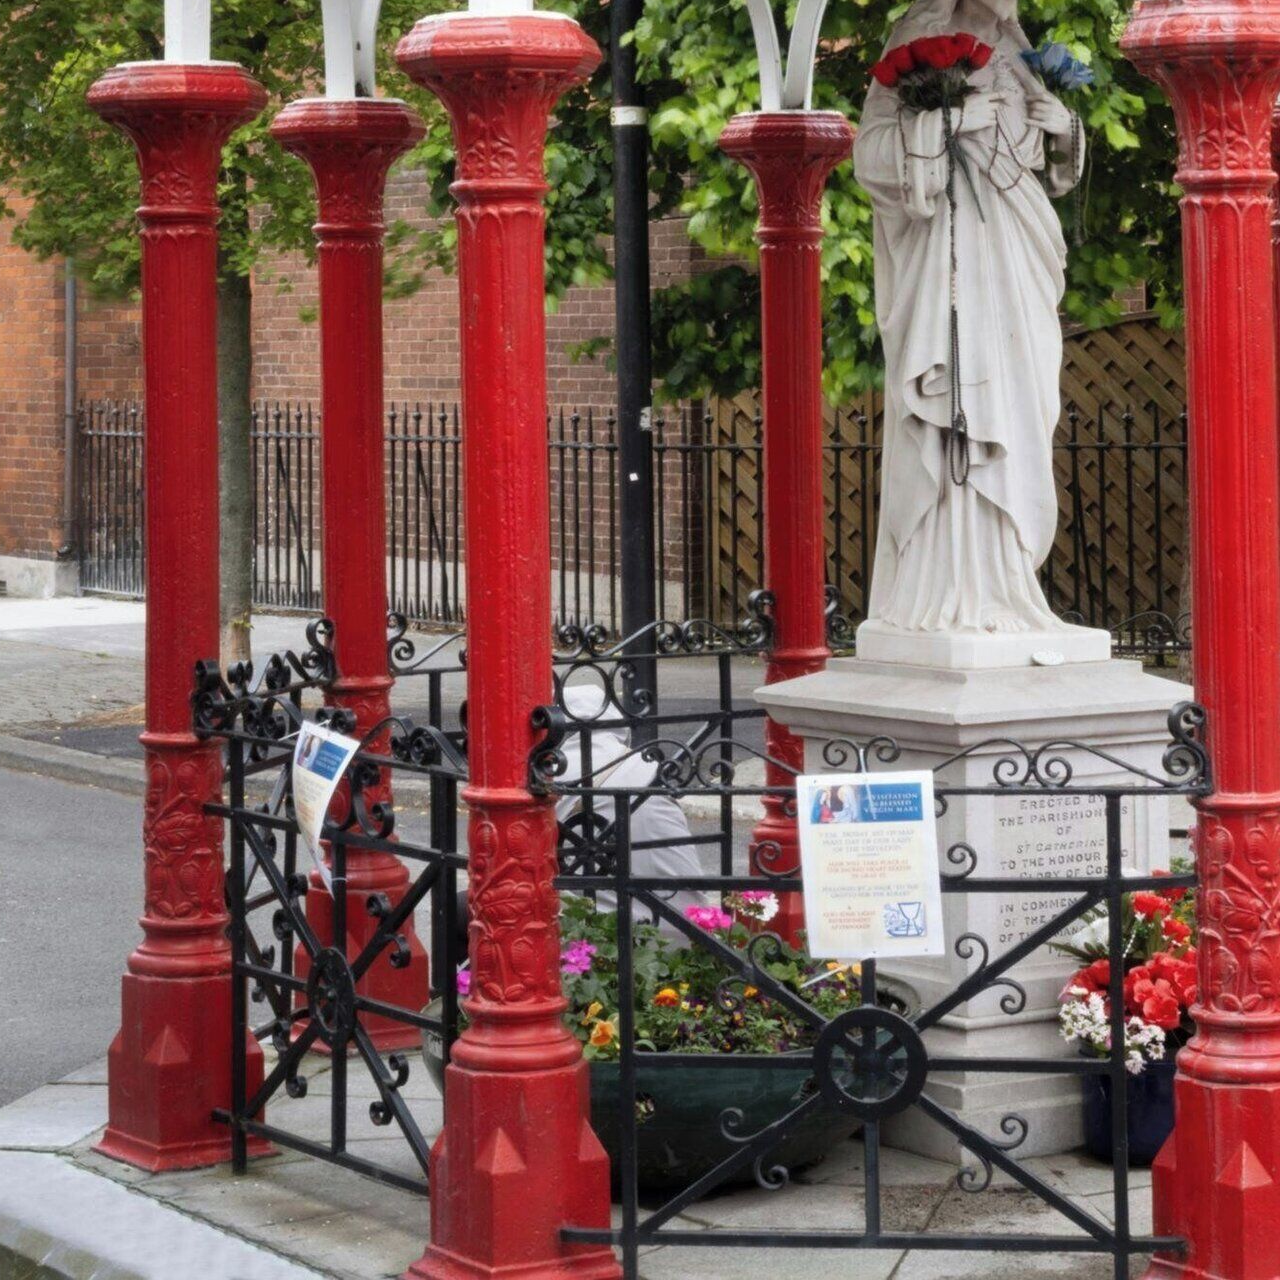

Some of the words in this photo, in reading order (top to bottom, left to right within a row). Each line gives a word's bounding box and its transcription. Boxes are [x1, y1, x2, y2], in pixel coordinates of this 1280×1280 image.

[1020, 796, 1080, 809] ERECTED
[999, 816, 1024, 827] THE
[1030, 806, 1128, 824] PARISHIONS
[1056, 826, 1072, 836] OF
[999, 860, 1016, 870] TO
[1022, 858, 1044, 869] THE
[1049, 851, 1101, 865] HONOUR
[1000, 904, 1014, 914] IN
[1004, 917, 1018, 928] OF
[1024, 915, 1046, 926] THE
[999, 933, 1013, 943] OF
